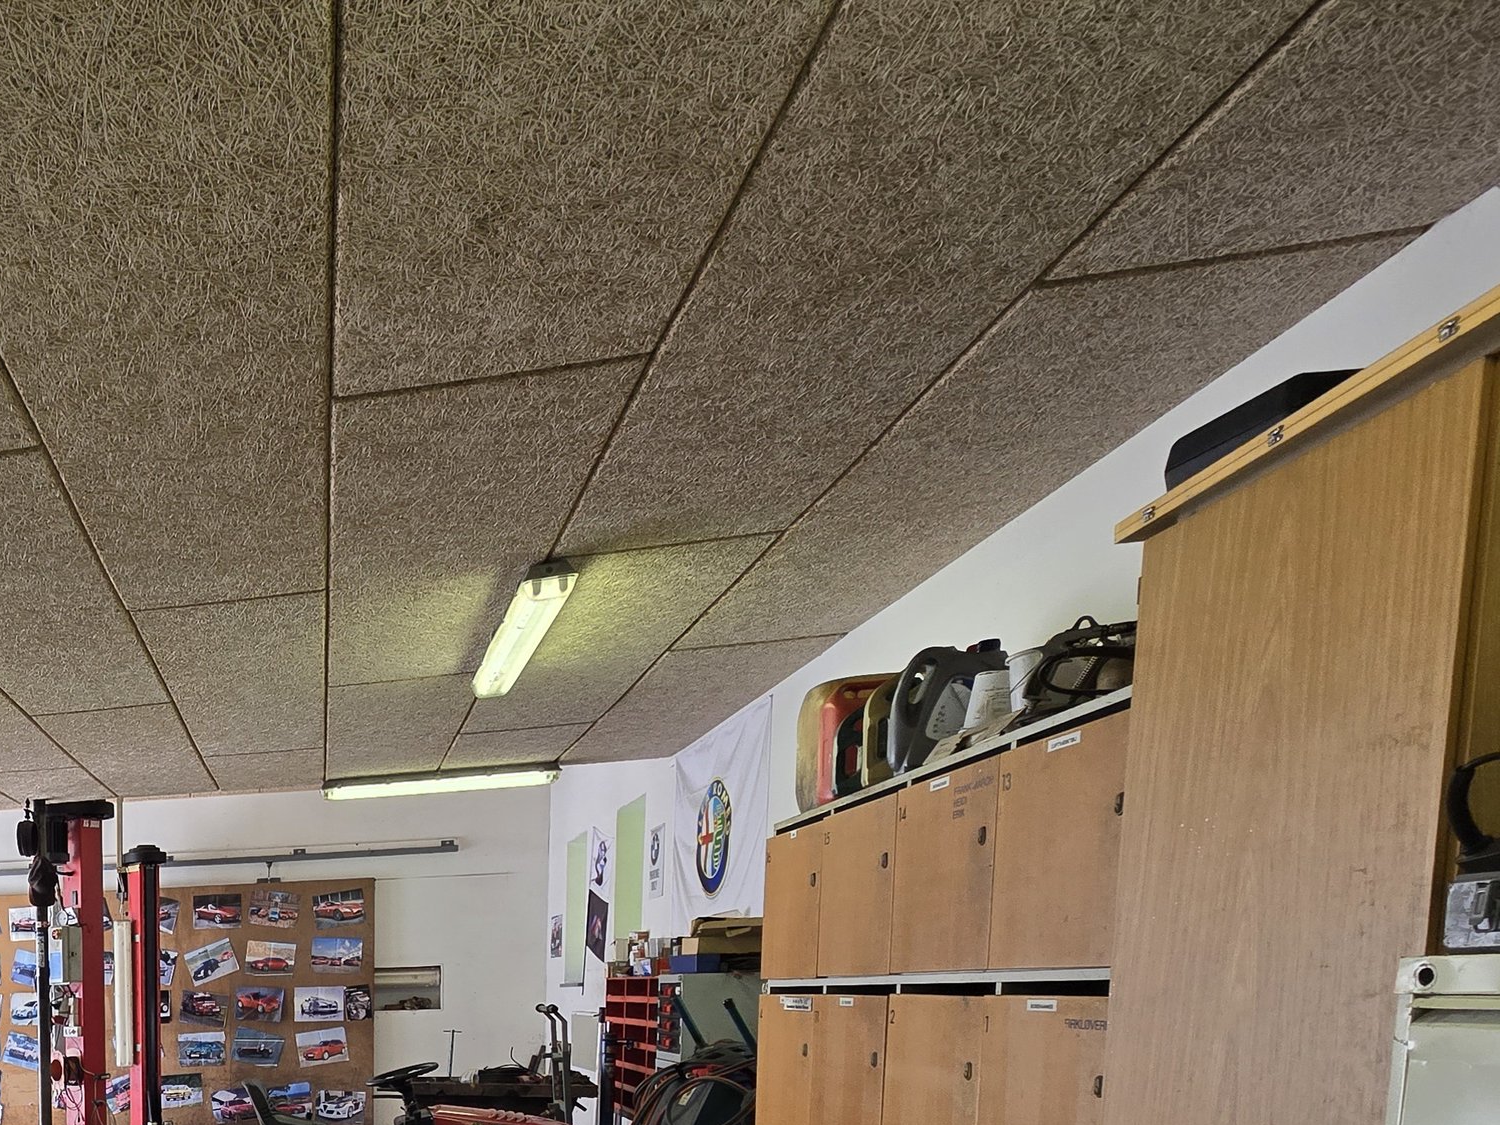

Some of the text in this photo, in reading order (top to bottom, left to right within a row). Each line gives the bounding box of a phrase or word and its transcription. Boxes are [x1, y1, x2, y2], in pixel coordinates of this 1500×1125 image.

[1002, 773, 1012, 791] 13
[898, 806, 907, 822] 14
[823, 831, 831, 846] 15
[889, 1009, 896, 1025] 2
[984, 1015, 990, 1033] 1
